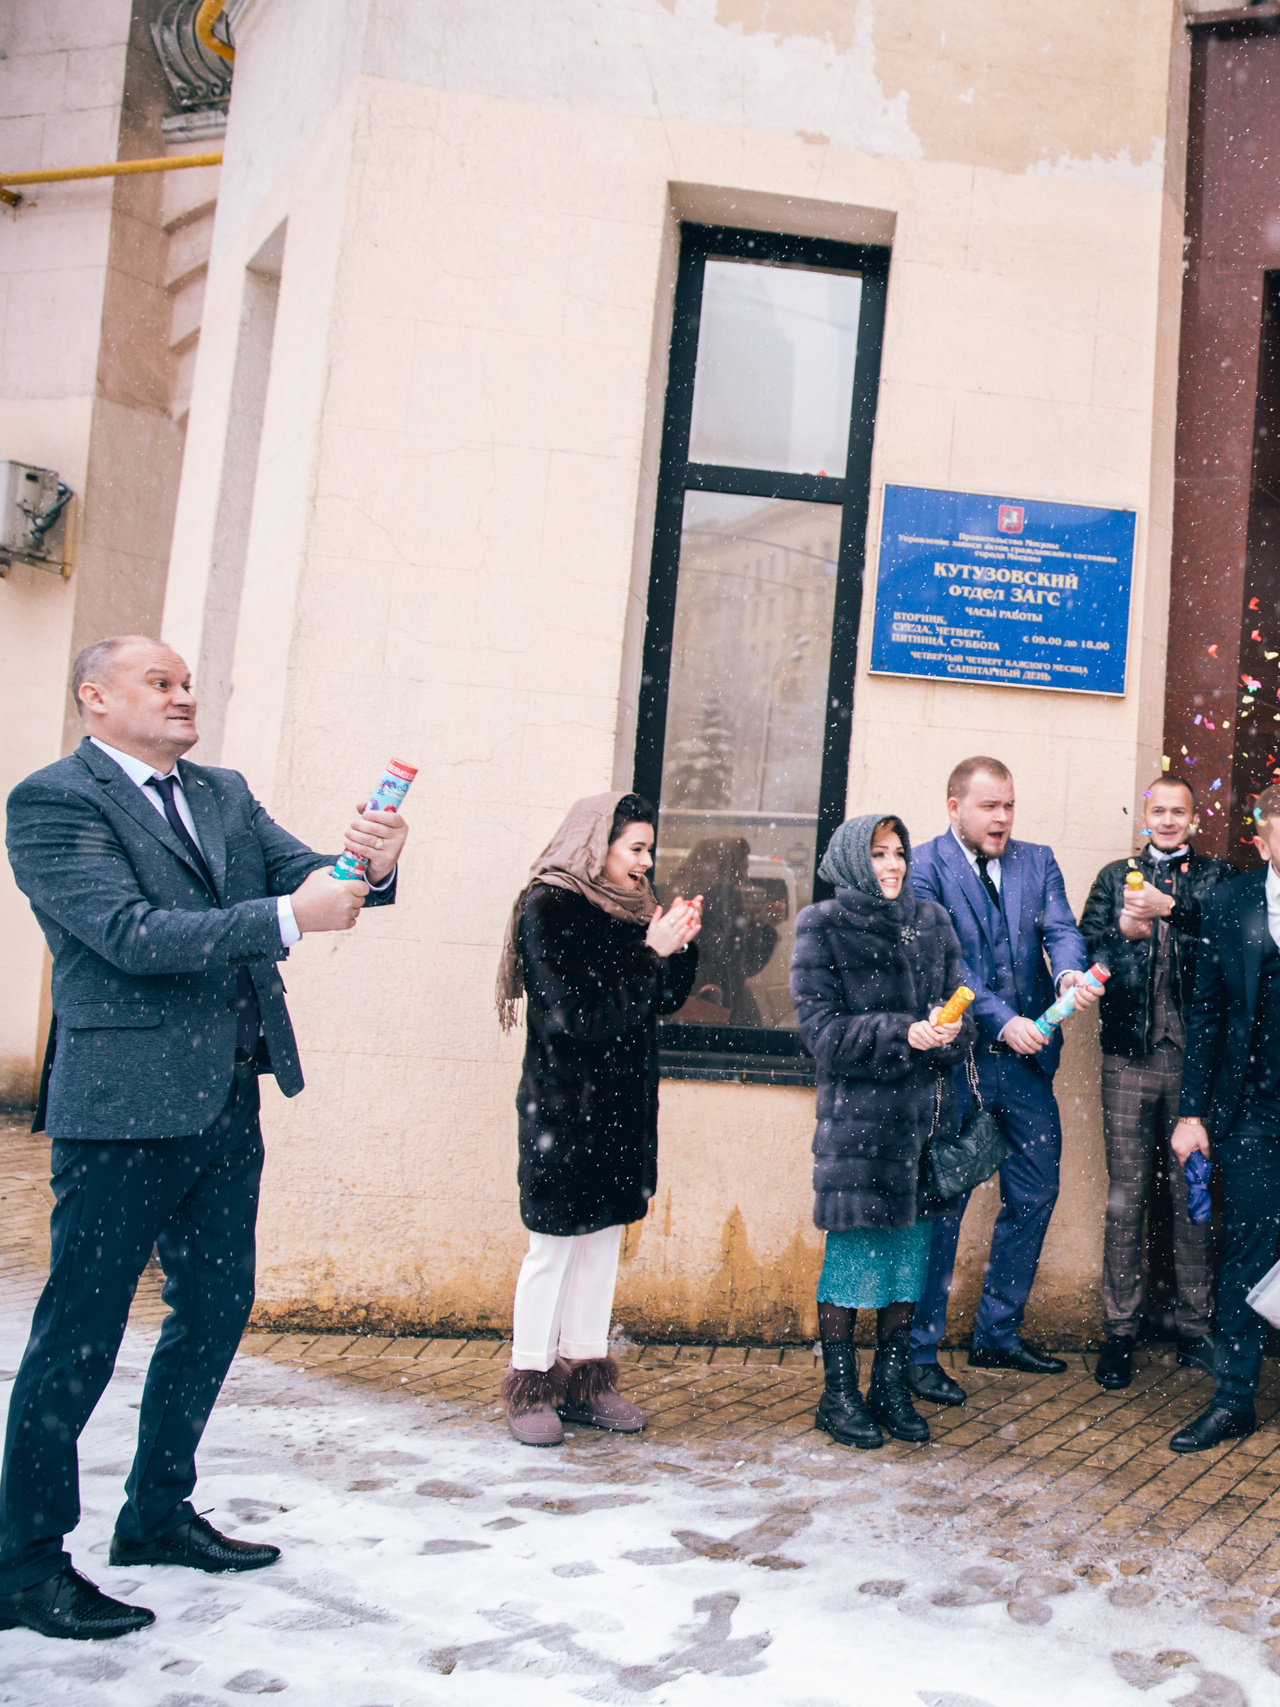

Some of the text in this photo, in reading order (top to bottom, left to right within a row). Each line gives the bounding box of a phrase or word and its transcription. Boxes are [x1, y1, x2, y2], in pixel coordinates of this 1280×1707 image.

[933, 562, 1079, 590] КУТУЗОВСКИЙ
[949, 584, 1061, 606] отдел ЗАГС
[965, 606, 1043, 622] ЧАСЫ РАБОТЫ
[950, 638, 1000, 651] СУББОТА
[1022, 635, 1110, 651] с 09.00 до 18.00
[947, 664, 1052, 681] САНИТАРНЫЙ ДЕНЬ
[965, 656, 1004, 666] ЧЕТВЕРГ
[1005, 660, 1051, 671] КАЖДОГО
[1052, 664, 1089, 674] МЕСЯЦА
